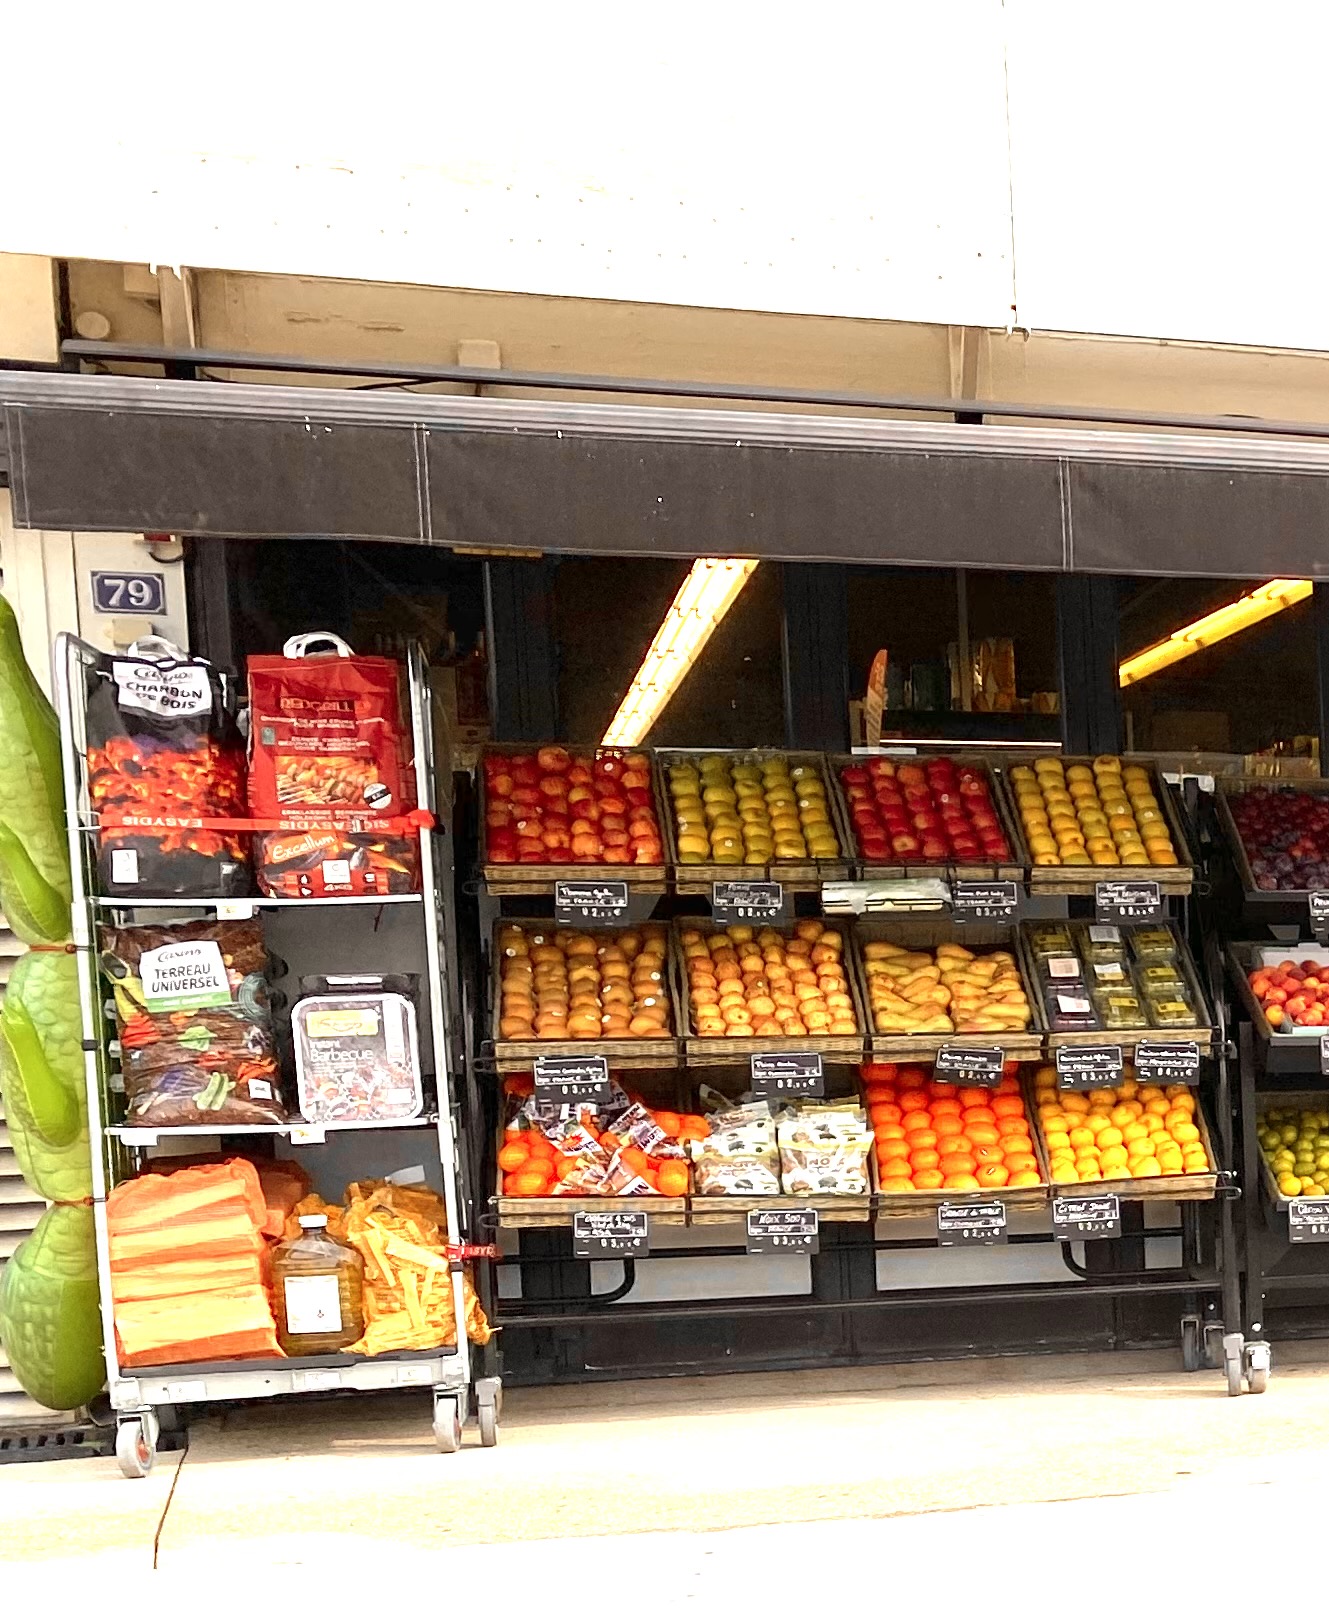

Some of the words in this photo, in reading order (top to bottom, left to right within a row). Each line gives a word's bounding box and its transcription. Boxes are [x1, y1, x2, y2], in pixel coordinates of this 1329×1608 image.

[104, 579, 153, 608] 79
[160, 696, 196, 709] BOIS
[122, 816, 203, 828] EASYDIS
[279, 819, 353, 831] EASYDIS
[272, 834, 336, 860] Excellum
[155, 963, 211, 979] TERREAU
[152, 975, 220, 993] UNIVERSEL
[310, 1047, 374, 1063] Barbecue
